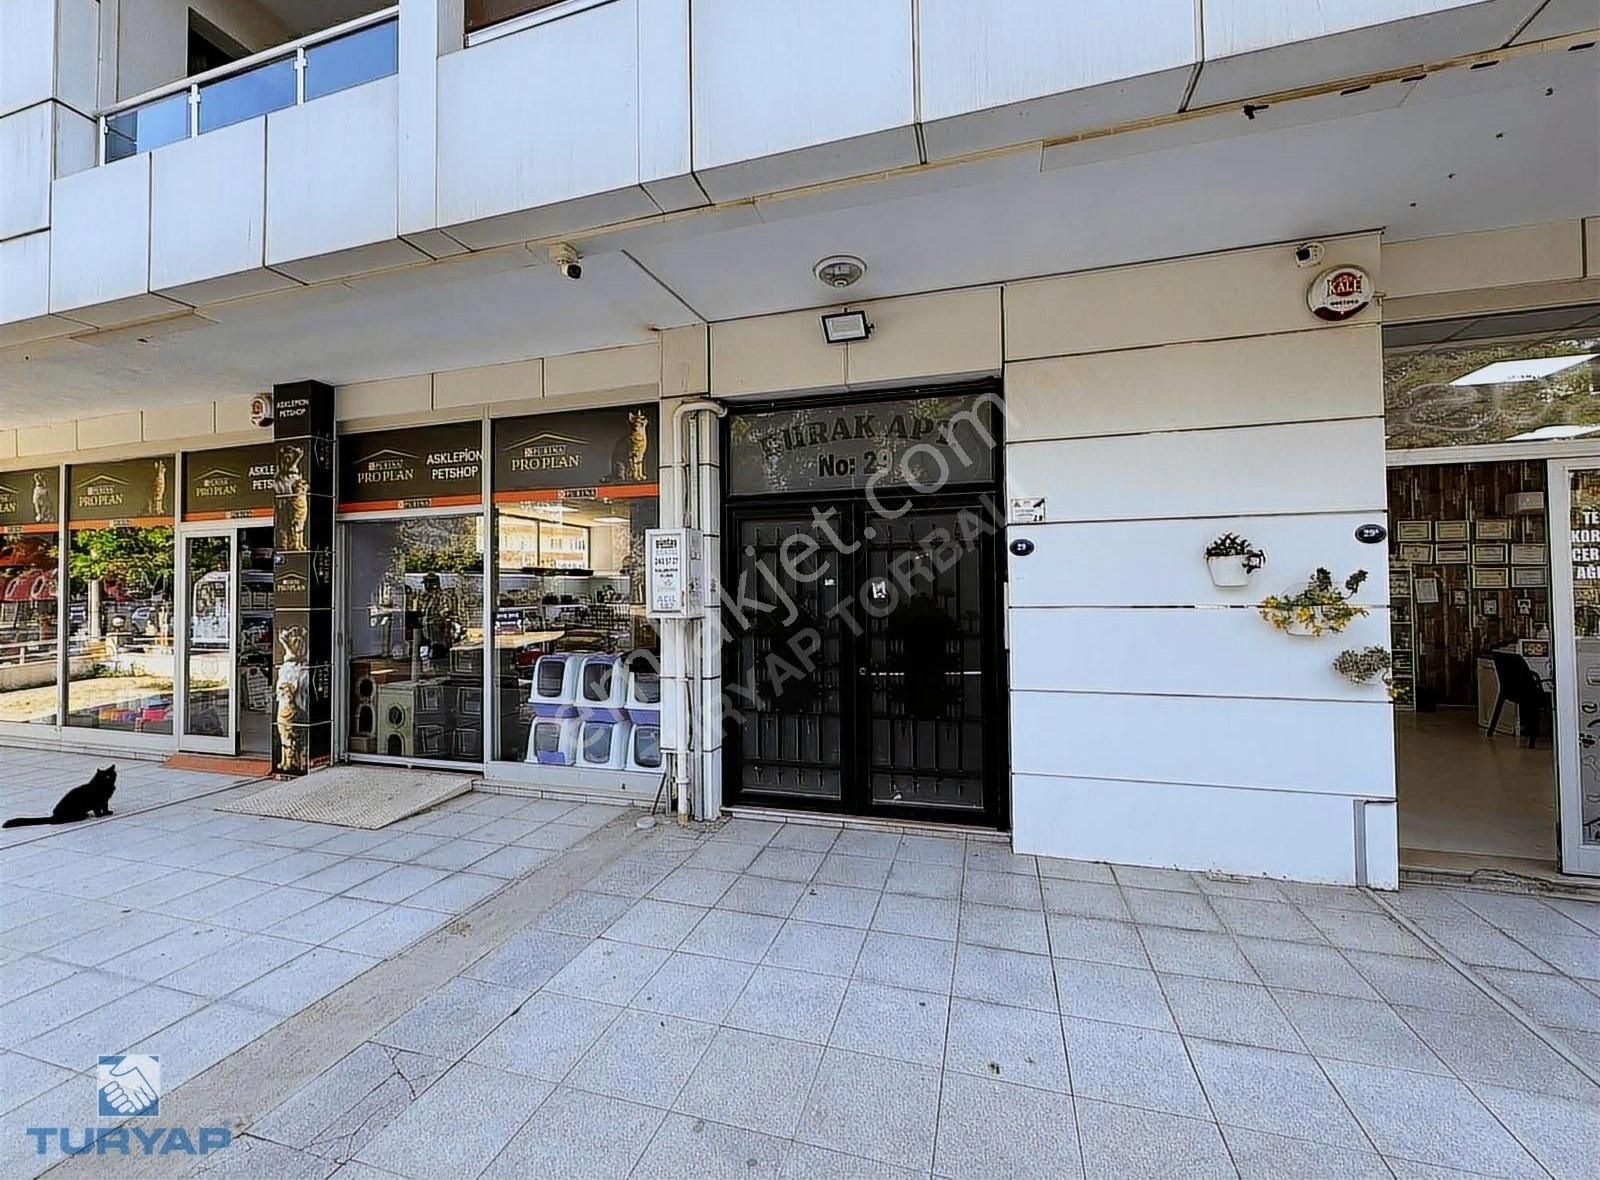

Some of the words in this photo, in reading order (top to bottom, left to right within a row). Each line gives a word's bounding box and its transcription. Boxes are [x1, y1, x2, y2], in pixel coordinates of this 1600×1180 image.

[1327, 275, 1363, 297] KALE
[511, 459, 540, 471] PRO
[542, 455, 579, 469] PLAN
[818, 454, 856, 477] No:
[357, 472, 381, 483] PRO
[383, 468, 414, 481] PLAN
[431, 466, 479, 480] PETSHOP
[195, 487, 213, 497] PRO
[214, 485, 237, 496] PLAN
[79, 496, 98, 508] PRO
[98, 494, 123, 506] PLAN
